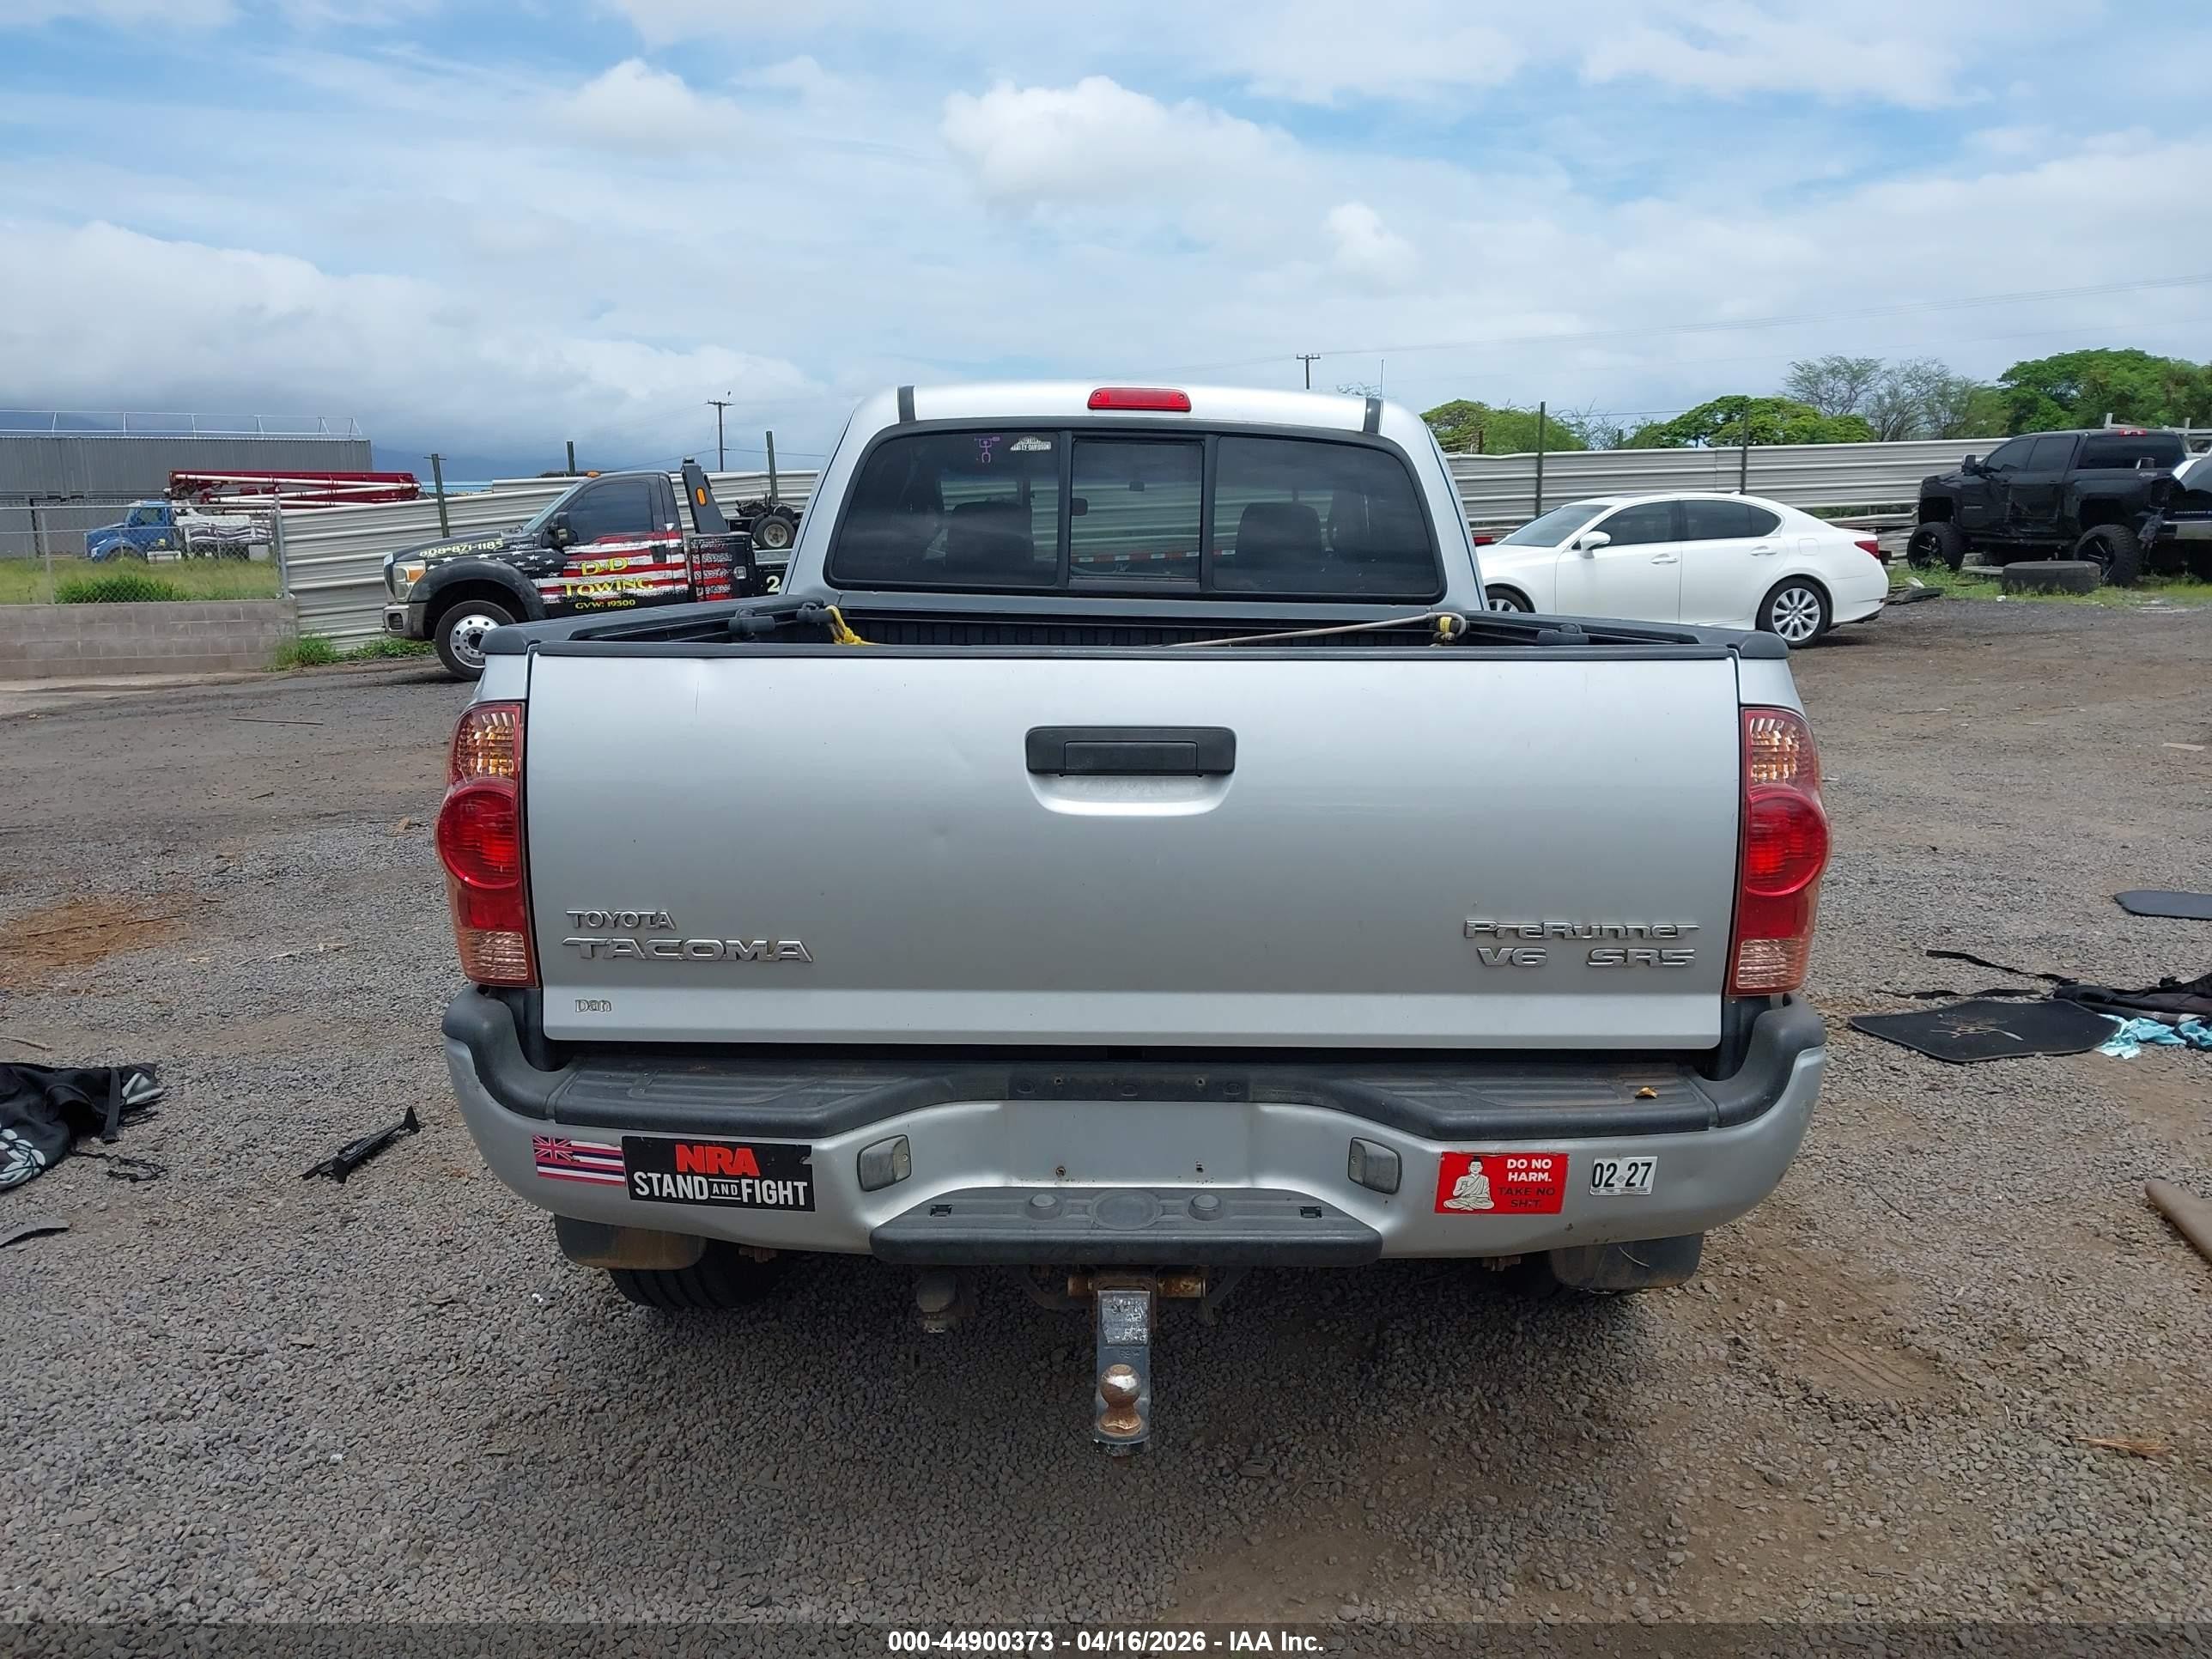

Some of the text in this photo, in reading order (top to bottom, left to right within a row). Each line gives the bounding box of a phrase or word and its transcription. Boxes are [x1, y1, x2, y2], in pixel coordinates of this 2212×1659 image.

[562, 577, 653, 597] TOWING
[766, 574, 781, 592] 2
[607, 599, 636, 608] 19500
[566, 909, 677, 930] TOYOTA
[1464, 919, 1700, 940] PreRunner
[562, 937, 813, 963] TACOMA
[1477, 947, 1697, 969] V6 SR5
[574, 999, 612, 1013] Dan
[675, 1144, 761, 1177] NRA
[1507, 1159, 1553, 1170] DO NO
[1508, 1171, 1553, 1182] HARM.
[1591, 1162, 1653, 1188] 02 27
[633, 1170, 808, 1206] STAND AND FIGHT
[1498, 1187, 1556, 1196] TAKE NO
